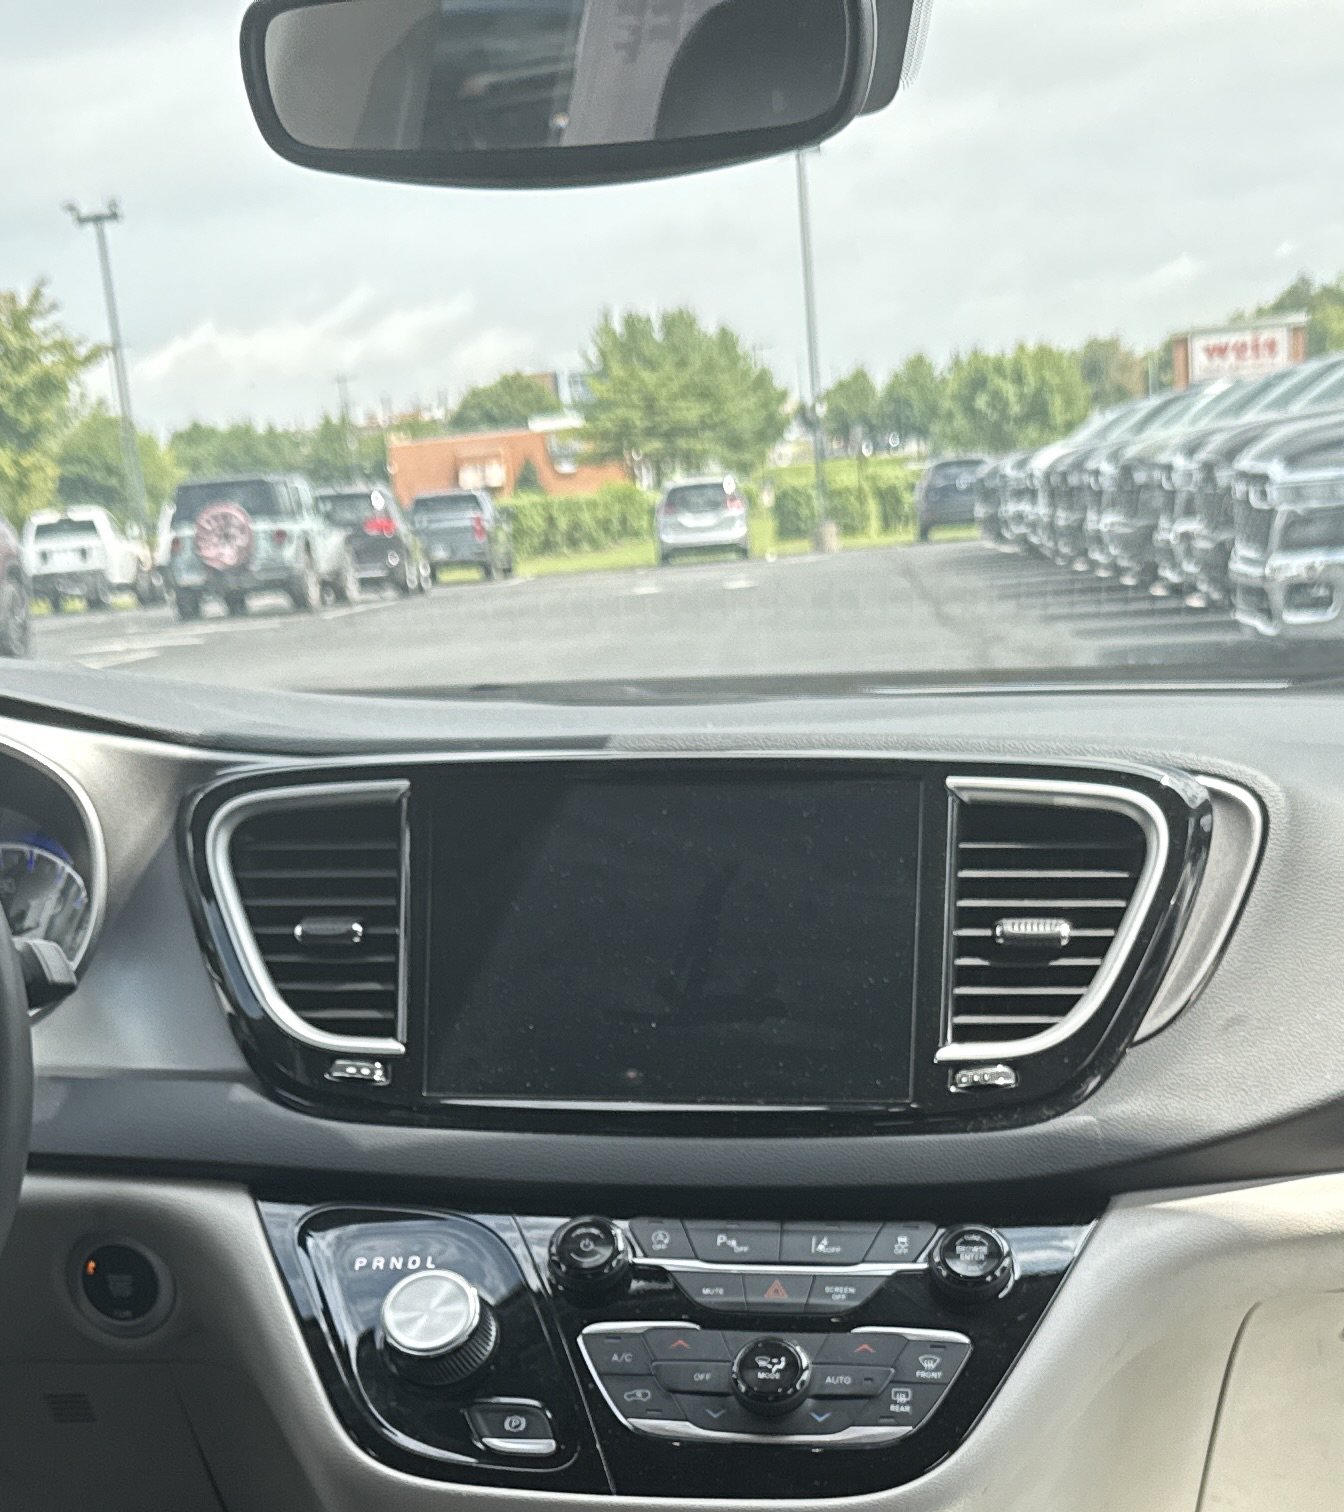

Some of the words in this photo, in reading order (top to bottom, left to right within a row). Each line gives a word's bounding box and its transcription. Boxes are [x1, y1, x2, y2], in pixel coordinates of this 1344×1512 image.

[702, 1287, 724, 1296] MUTE
[825, 1285, 856, 1294] SCREEN
[832, 1293, 847, 1301] OFF
[611, 1353, 633, 1363] A/C
[693, 1371, 712, 1382] OFF
[825, 1374, 853, 1386] AUTO
[915, 1370, 943, 1380] FRONT
[889, 1404, 911, 1414] REAR
